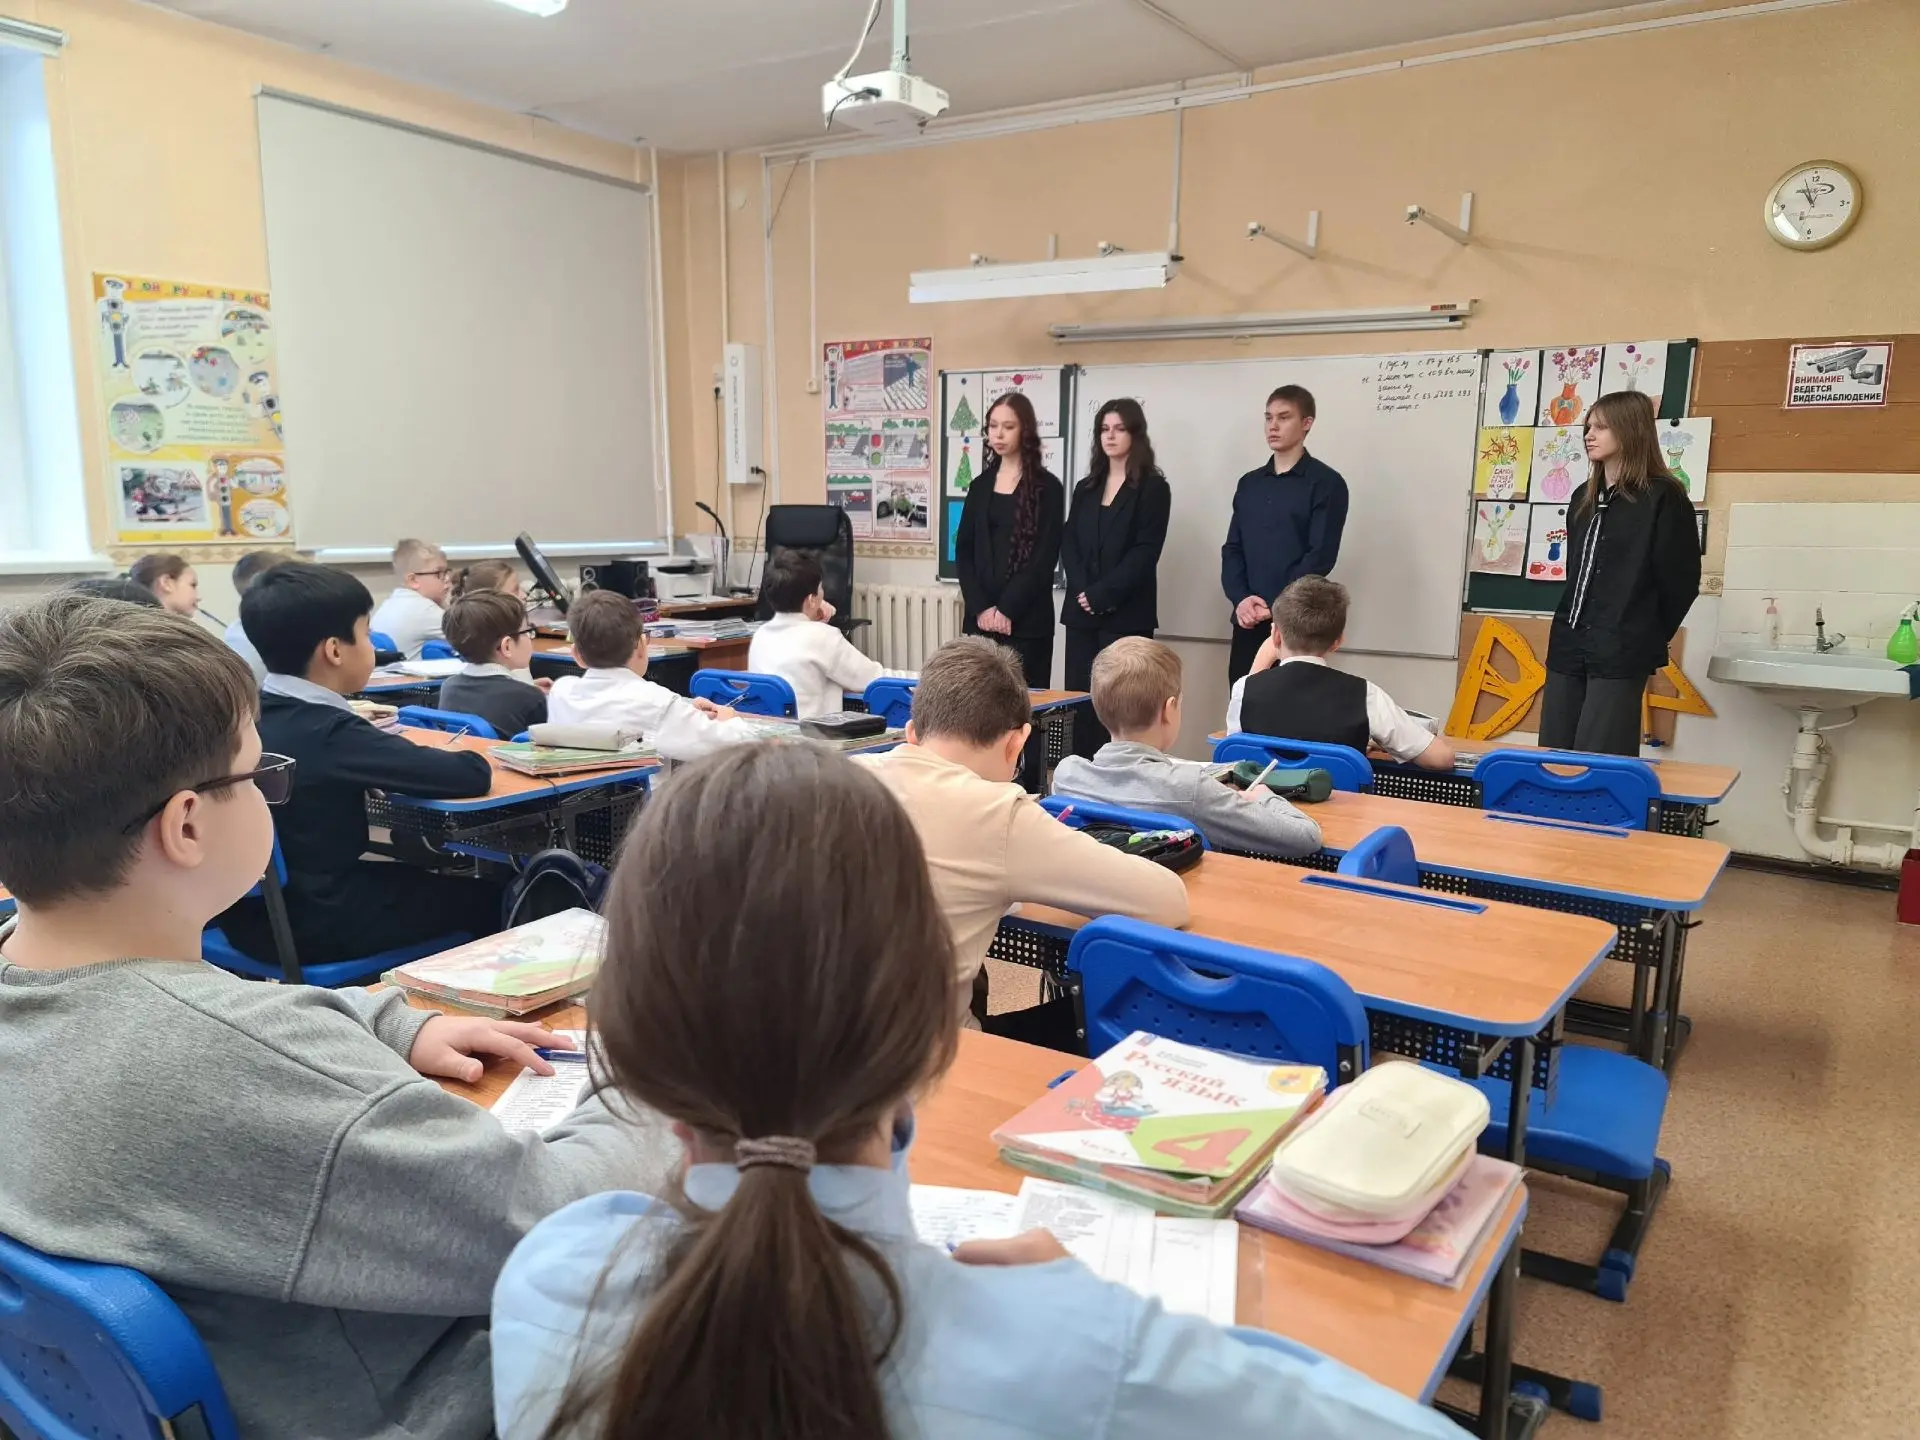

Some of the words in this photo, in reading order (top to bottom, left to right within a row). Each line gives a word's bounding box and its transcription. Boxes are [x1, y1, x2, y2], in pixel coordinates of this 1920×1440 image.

[1795, 375, 1844, 384] ВНИМАНИЕ!
[1794, 385, 1832, 394] ВЕДЕТСЯ
[1793, 393, 1882, 402] ВИДЕОНАБЛЮДЕНИЕ
[1124, 1051, 1225, 1088] Русский
[1152, 1127, 1252, 1170] 4
